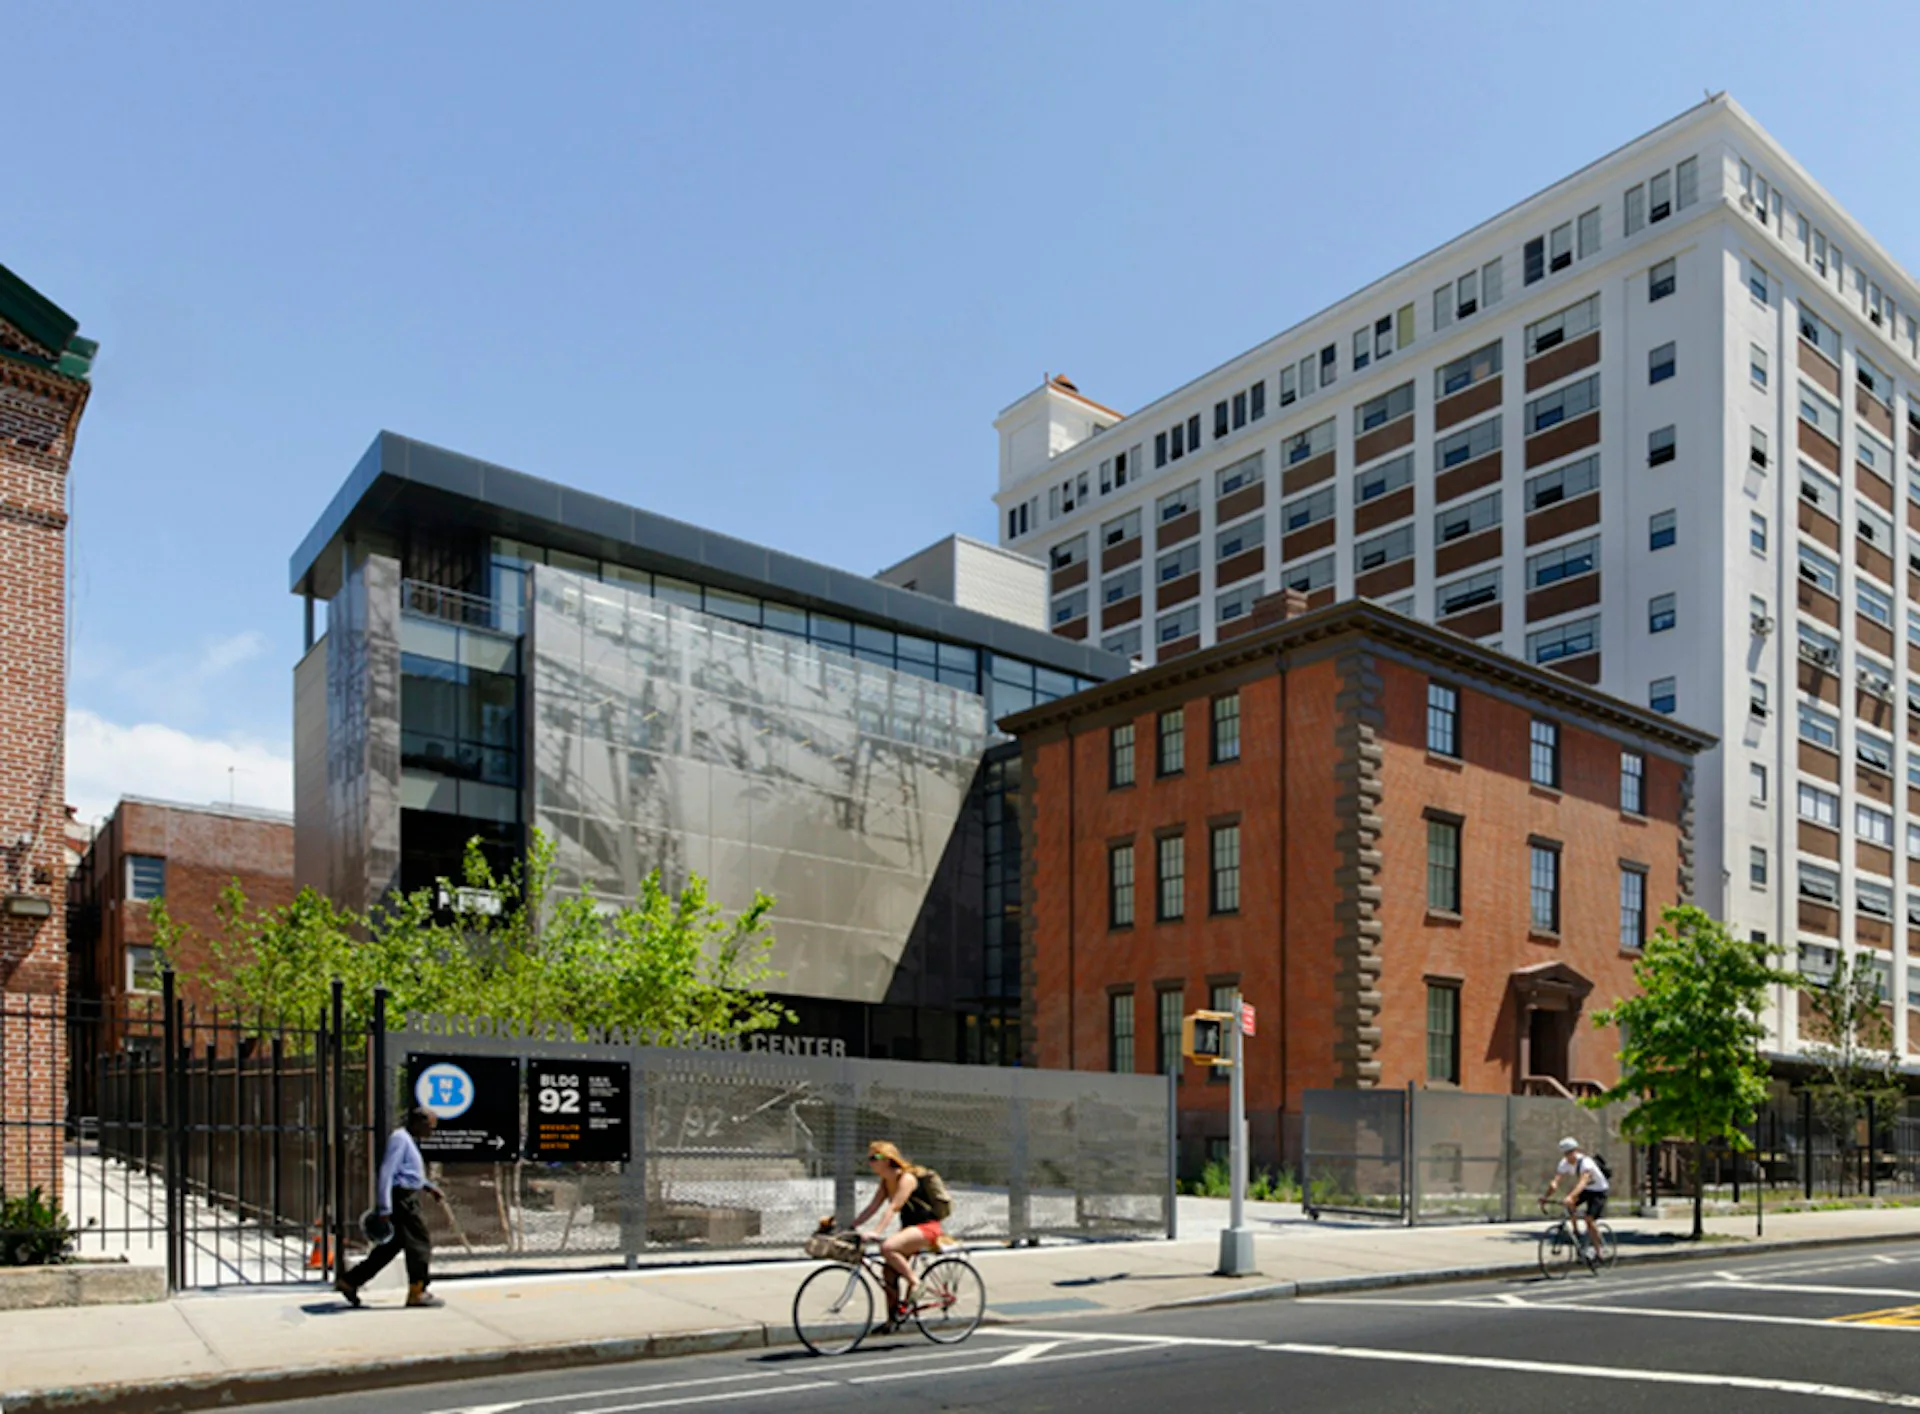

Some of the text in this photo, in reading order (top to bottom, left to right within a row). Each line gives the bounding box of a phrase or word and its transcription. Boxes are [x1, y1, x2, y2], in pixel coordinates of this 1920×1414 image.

[406, 1010, 847, 1058] BROOKLYN NAVY YARD CENTER
[540, 1073, 580, 1088] BLDG
[538, 1088, 580, 1114] 92
